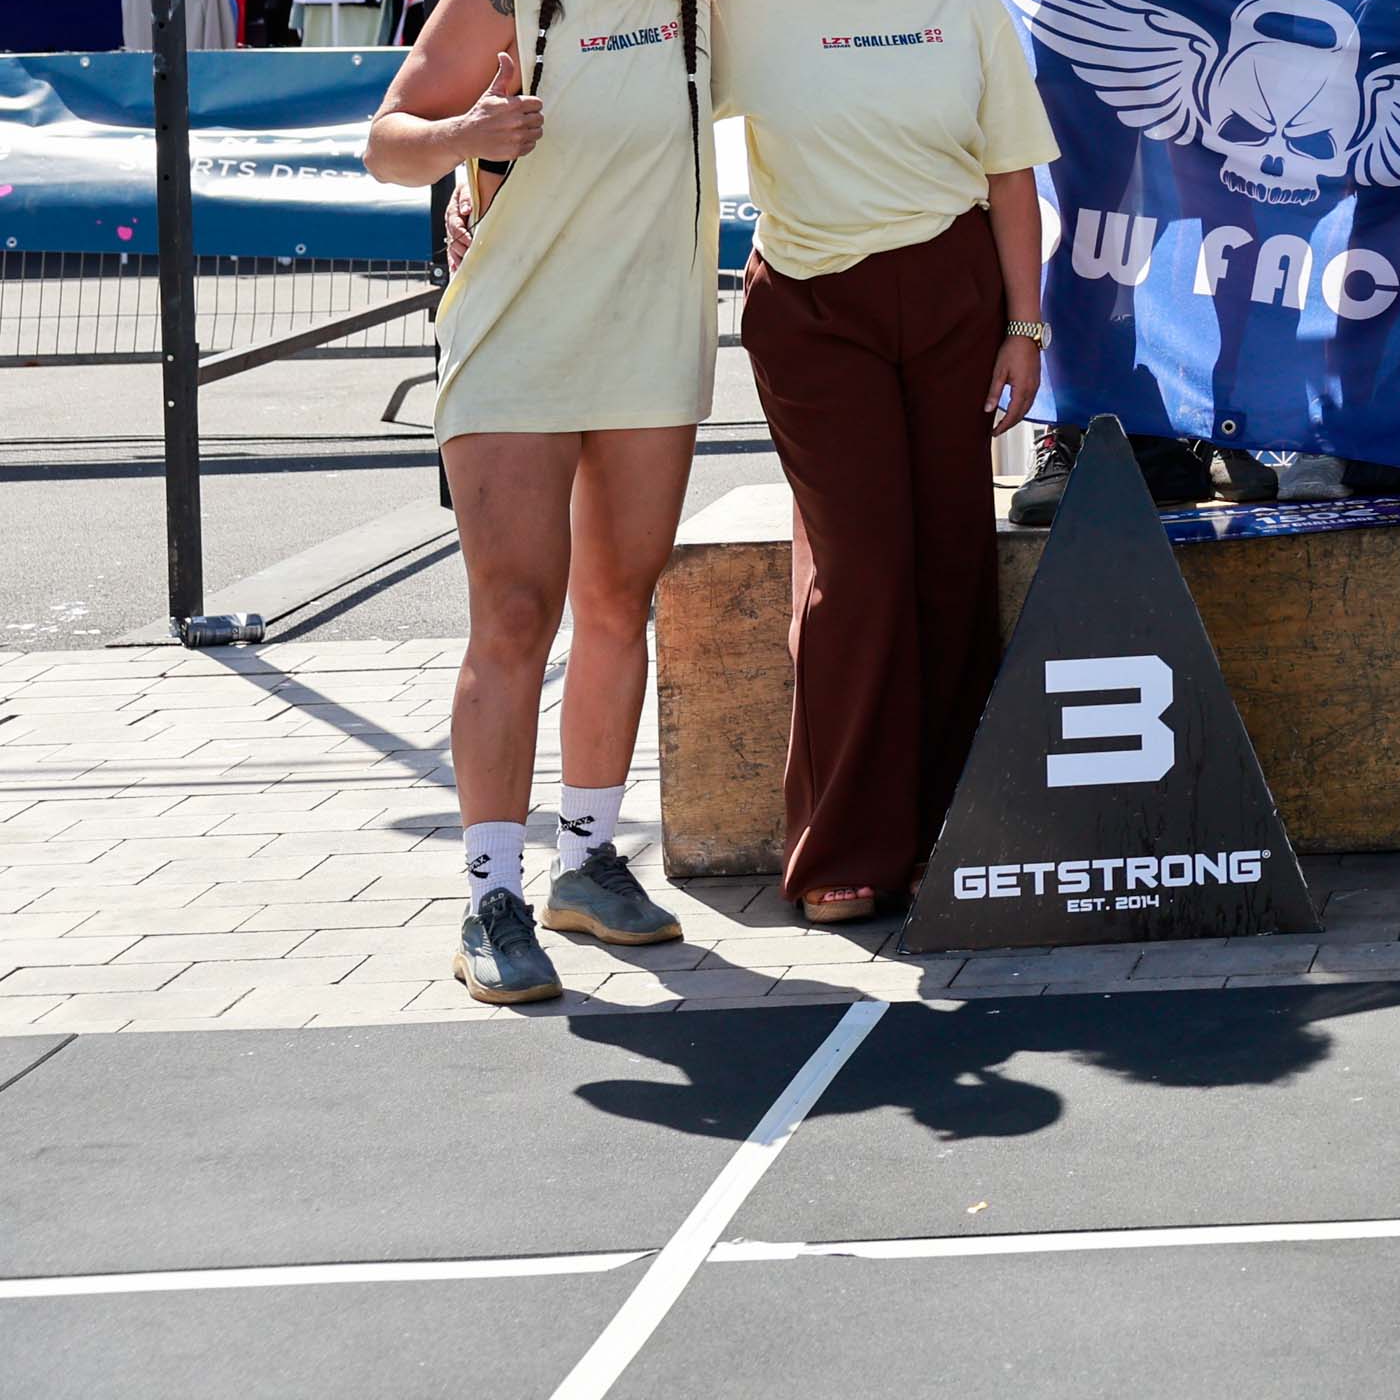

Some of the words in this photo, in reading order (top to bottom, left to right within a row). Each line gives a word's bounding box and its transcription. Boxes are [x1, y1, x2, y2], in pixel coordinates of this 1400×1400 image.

[579, 36, 608, 48] LZT
[606, 27, 662, 51] CHALLENGE
[821, 36, 852, 46] LZT
[853, 32, 925, 48] CHALLENGE
[1045, 654, 1176, 788] 3
[953, 850, 1263, 900] GETSTRONG
[1066, 898, 1112, 913] EST.
[1115, 894, 1160, 911] 2014
